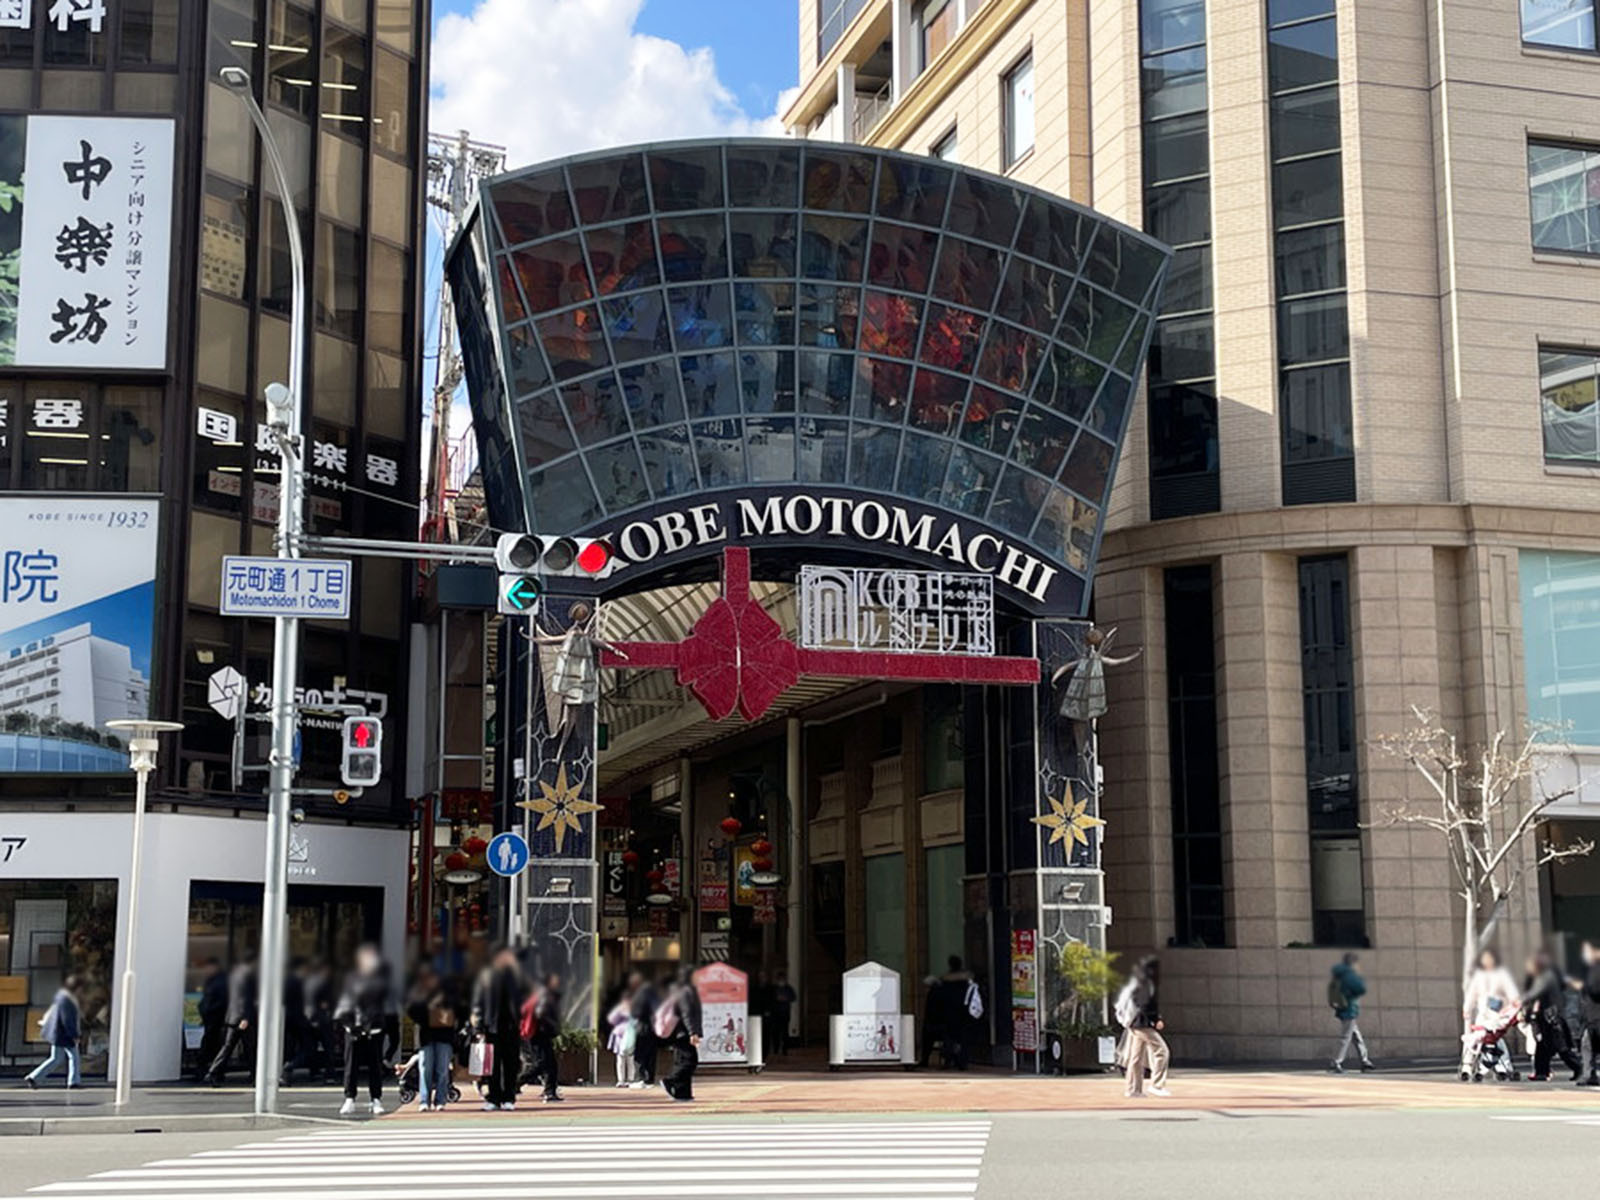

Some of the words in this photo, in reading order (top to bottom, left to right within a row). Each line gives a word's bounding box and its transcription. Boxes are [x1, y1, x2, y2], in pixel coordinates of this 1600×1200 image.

[124, 141, 146, 346] シニア向け分譲マンション
[0, 399, 83, 427] 器
[28, 513, 60, 521] KOBE
[67, 513, 104, 521] SINCE
[107, 511, 149, 528] 1932
[737, 495, 1058, 603] MOTOMACHI
[3, 549, 58, 603] 院
[228, 566, 343, 594] 元町通1丁目
[859, 571, 940, 610] KOBE
[308, 595, 340, 609] Chome
[2, 837, 26, 862] ア
[609, 852, 624, 893] ほぐし
